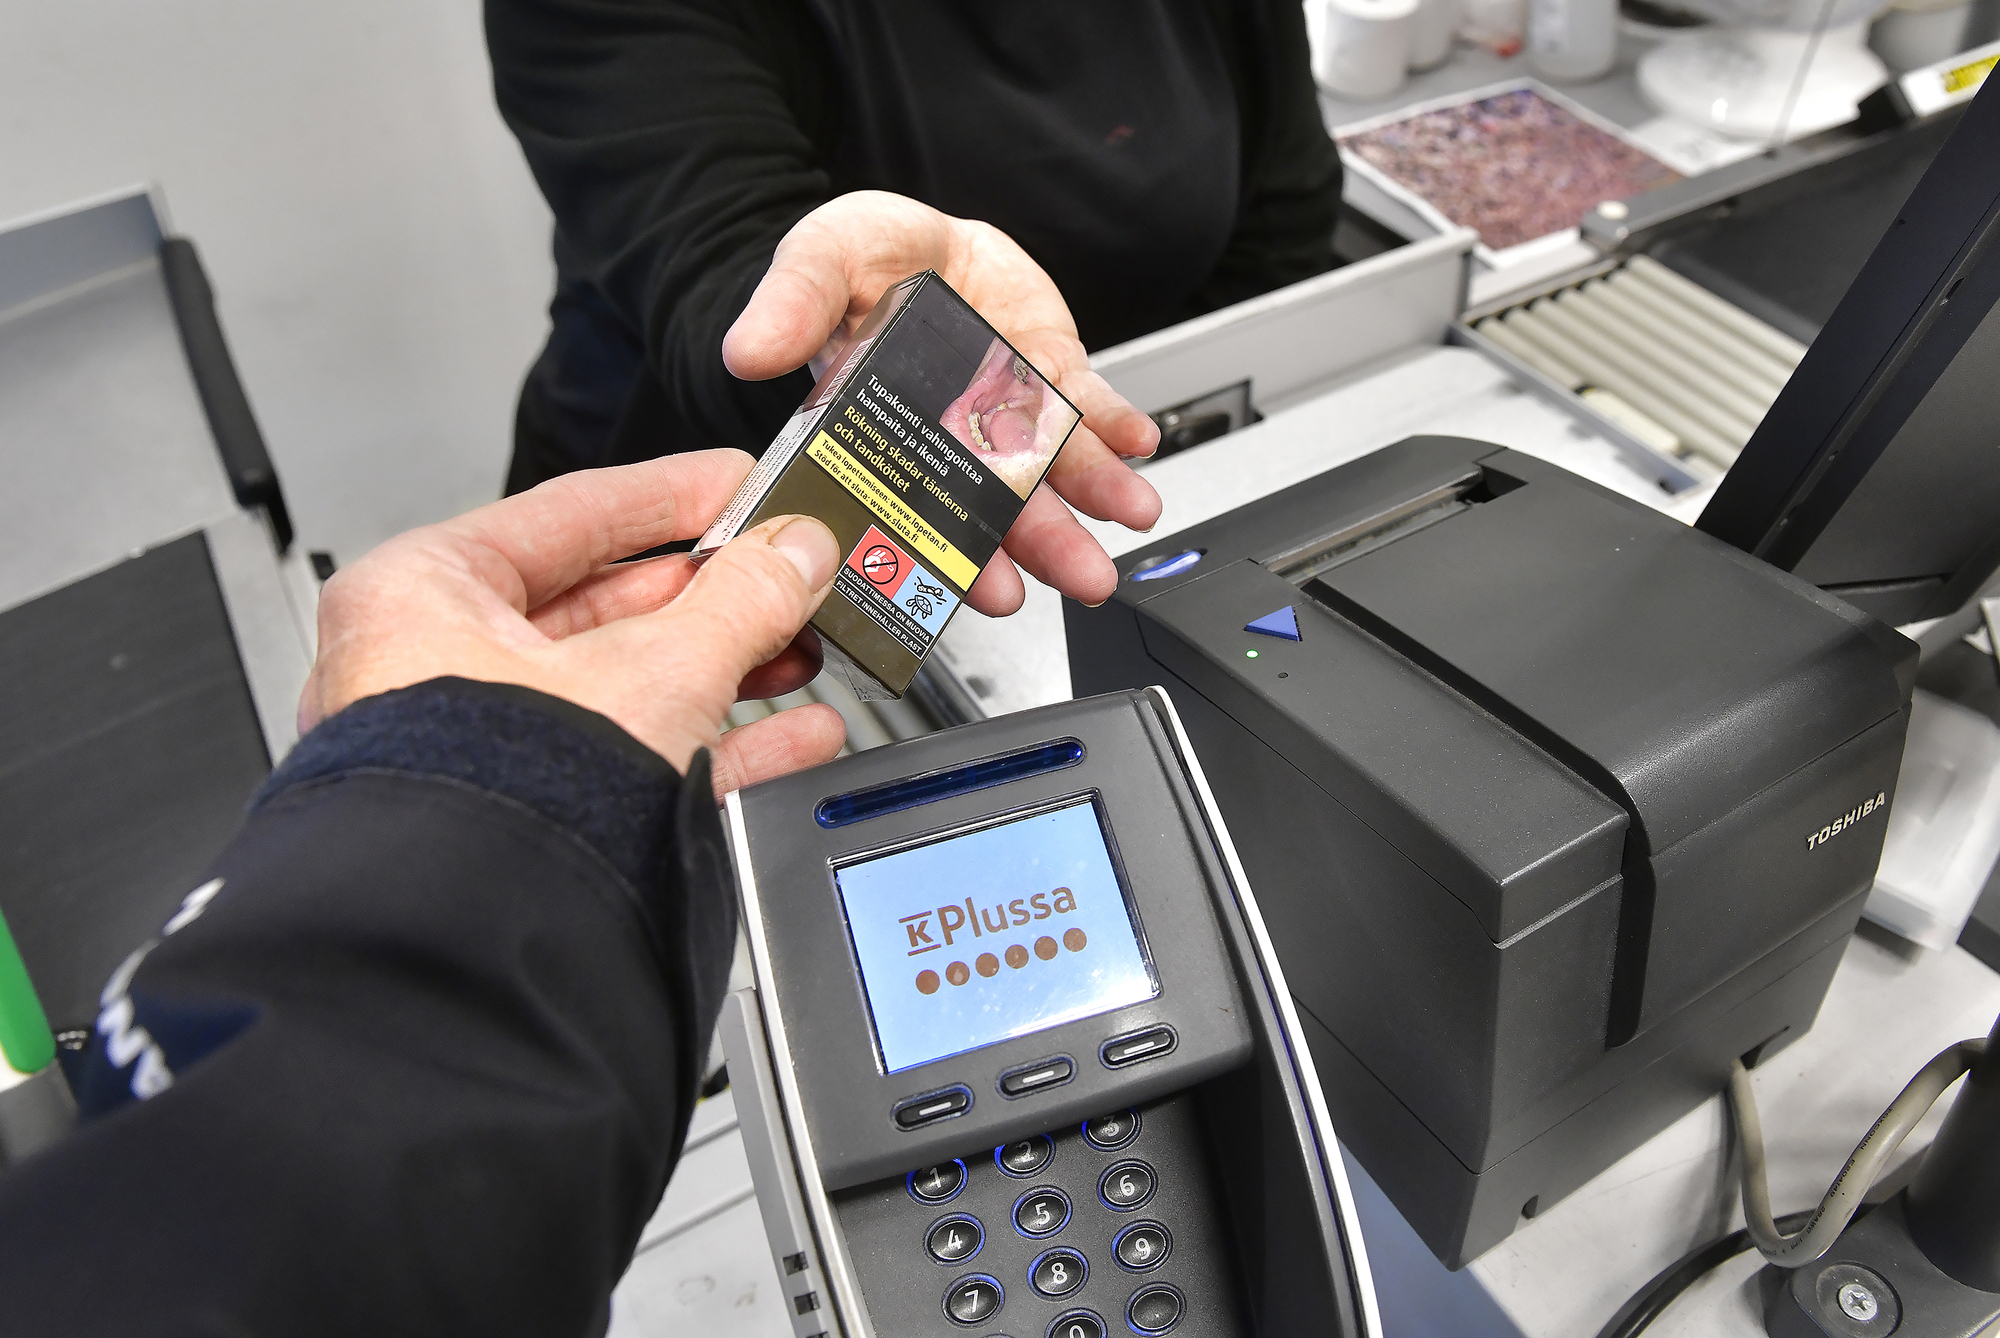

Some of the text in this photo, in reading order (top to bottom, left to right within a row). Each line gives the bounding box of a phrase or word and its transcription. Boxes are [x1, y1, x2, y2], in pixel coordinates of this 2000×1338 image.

[856, 388, 906, 439] hampaita
[903, 433, 918, 449] ja
[916, 443, 951, 478] ikeniä
[867, 374, 923, 429] Tupakointi
[920, 424, 983, 486] vahingoittaa
[834, 422, 855, 443] och
[854, 439, 911, 493] tandköttet
[844, 405, 888, 451] Rökning
[887, 445, 924, 480] skadar
[922, 475, 969, 522] tänderna
[814, 449, 919, 544] Stöd för att sluta: www.sluta.fi
[822, 439, 842, 461] Tukea
[841, 457, 890, 504] lopettamiseen:
[890, 500, 949, 553] www.lopetan.fi
[836, 580, 923, 654] FILTRET INNEHÅLLER PLAST
[843, 567, 930, 643] SUODATTIMESSA ON MUOVIA
[1807, 791, 1885, 851] TOSHIBA
[1103, 1115, 1120, 1137] 3
[1015, 1141, 1035, 1164] 2
[929, 1167, 942, 1189] 1
[1119, 1174, 1136, 1197] 6
[1035, 1202, 1051, 1226] 5
[947, 1229, 963, 1251] 4
[1135, 1237, 1152, 1260] 9
[1051, 1262, 1068, 1285] 8
[965, 1289, 980, 1313] 7
